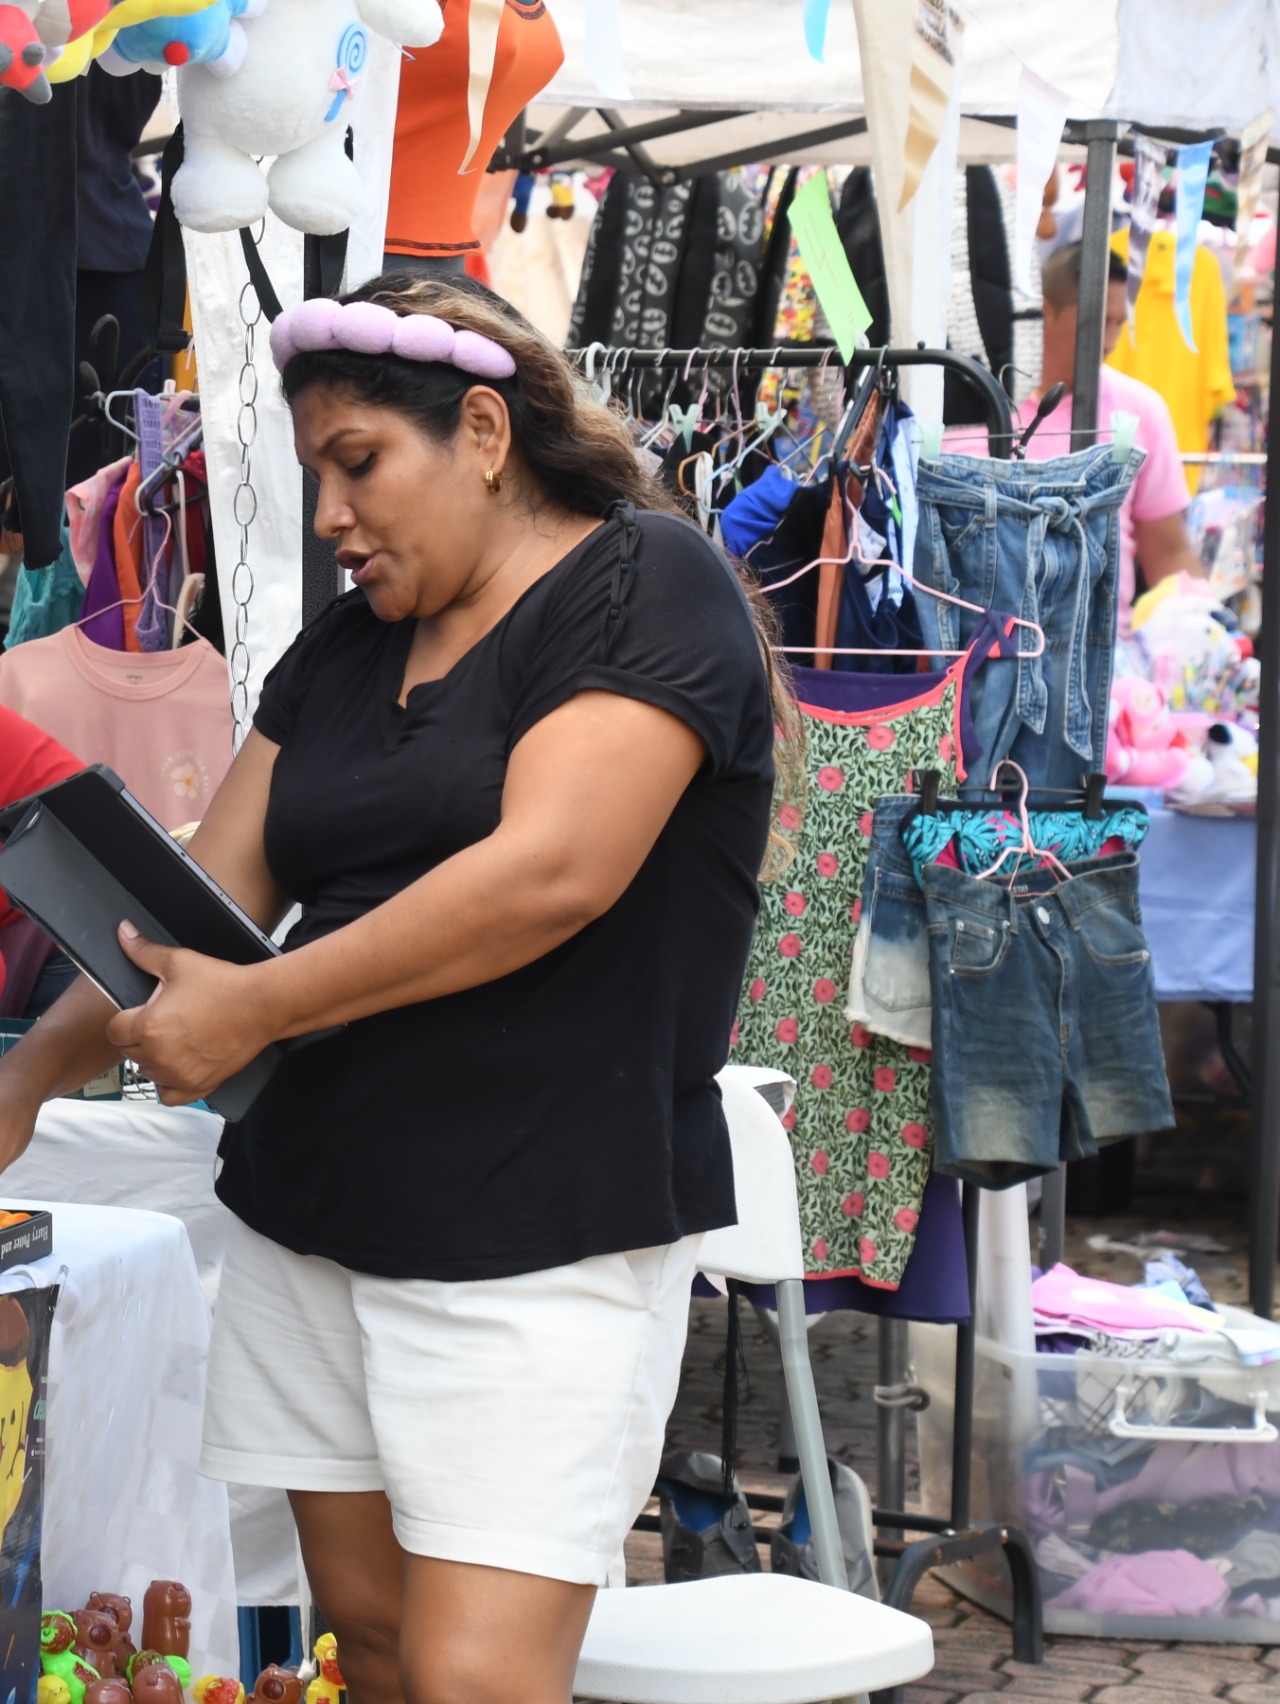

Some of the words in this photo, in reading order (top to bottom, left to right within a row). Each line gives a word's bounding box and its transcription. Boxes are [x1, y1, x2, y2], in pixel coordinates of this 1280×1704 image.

[13, 1232, 30, 1251] Potter
[31, 1225, 49, 1244] Harry
[1, 1240, 12, 1259] and
